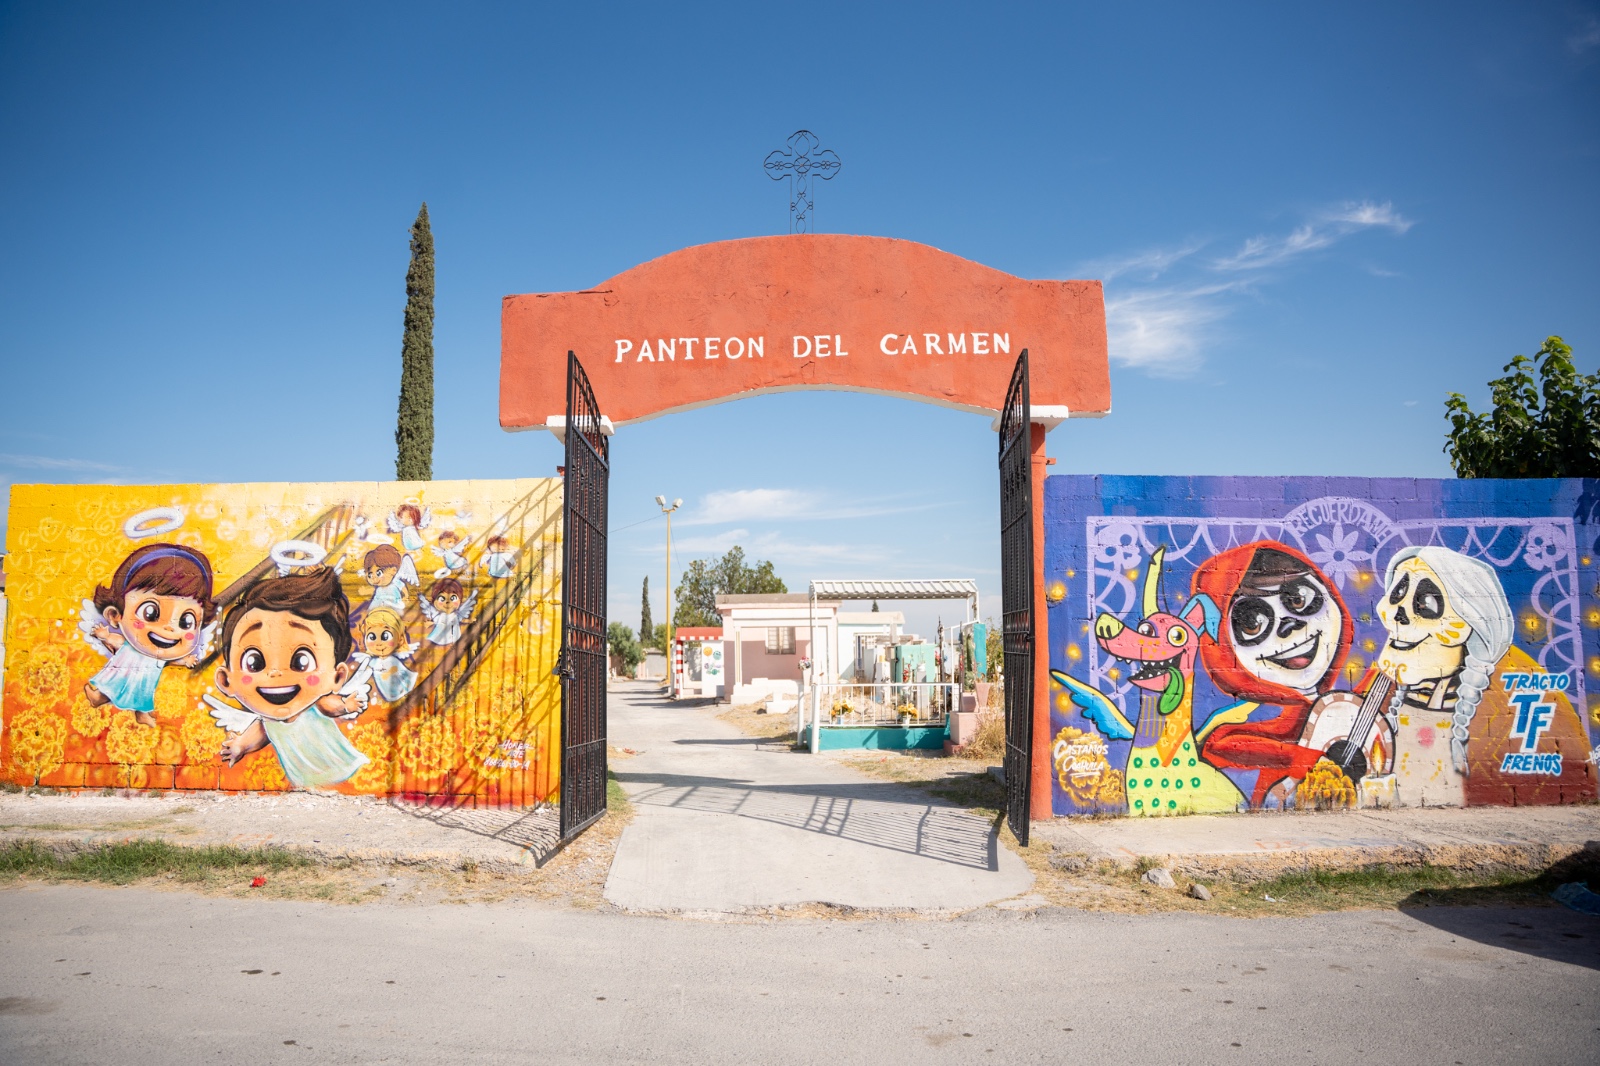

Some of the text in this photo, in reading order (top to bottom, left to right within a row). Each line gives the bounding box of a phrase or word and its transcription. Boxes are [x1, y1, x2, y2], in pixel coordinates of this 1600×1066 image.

[614, 332, 1010, 363] PANTEON DEL CARMEN
[1284, 501, 1394, 539] RECUERDAME
[1500, 672, 1570, 691] TRACTO
[1508, 691, 1557, 753] TF
[1500, 753, 1562, 776] FRENOS
